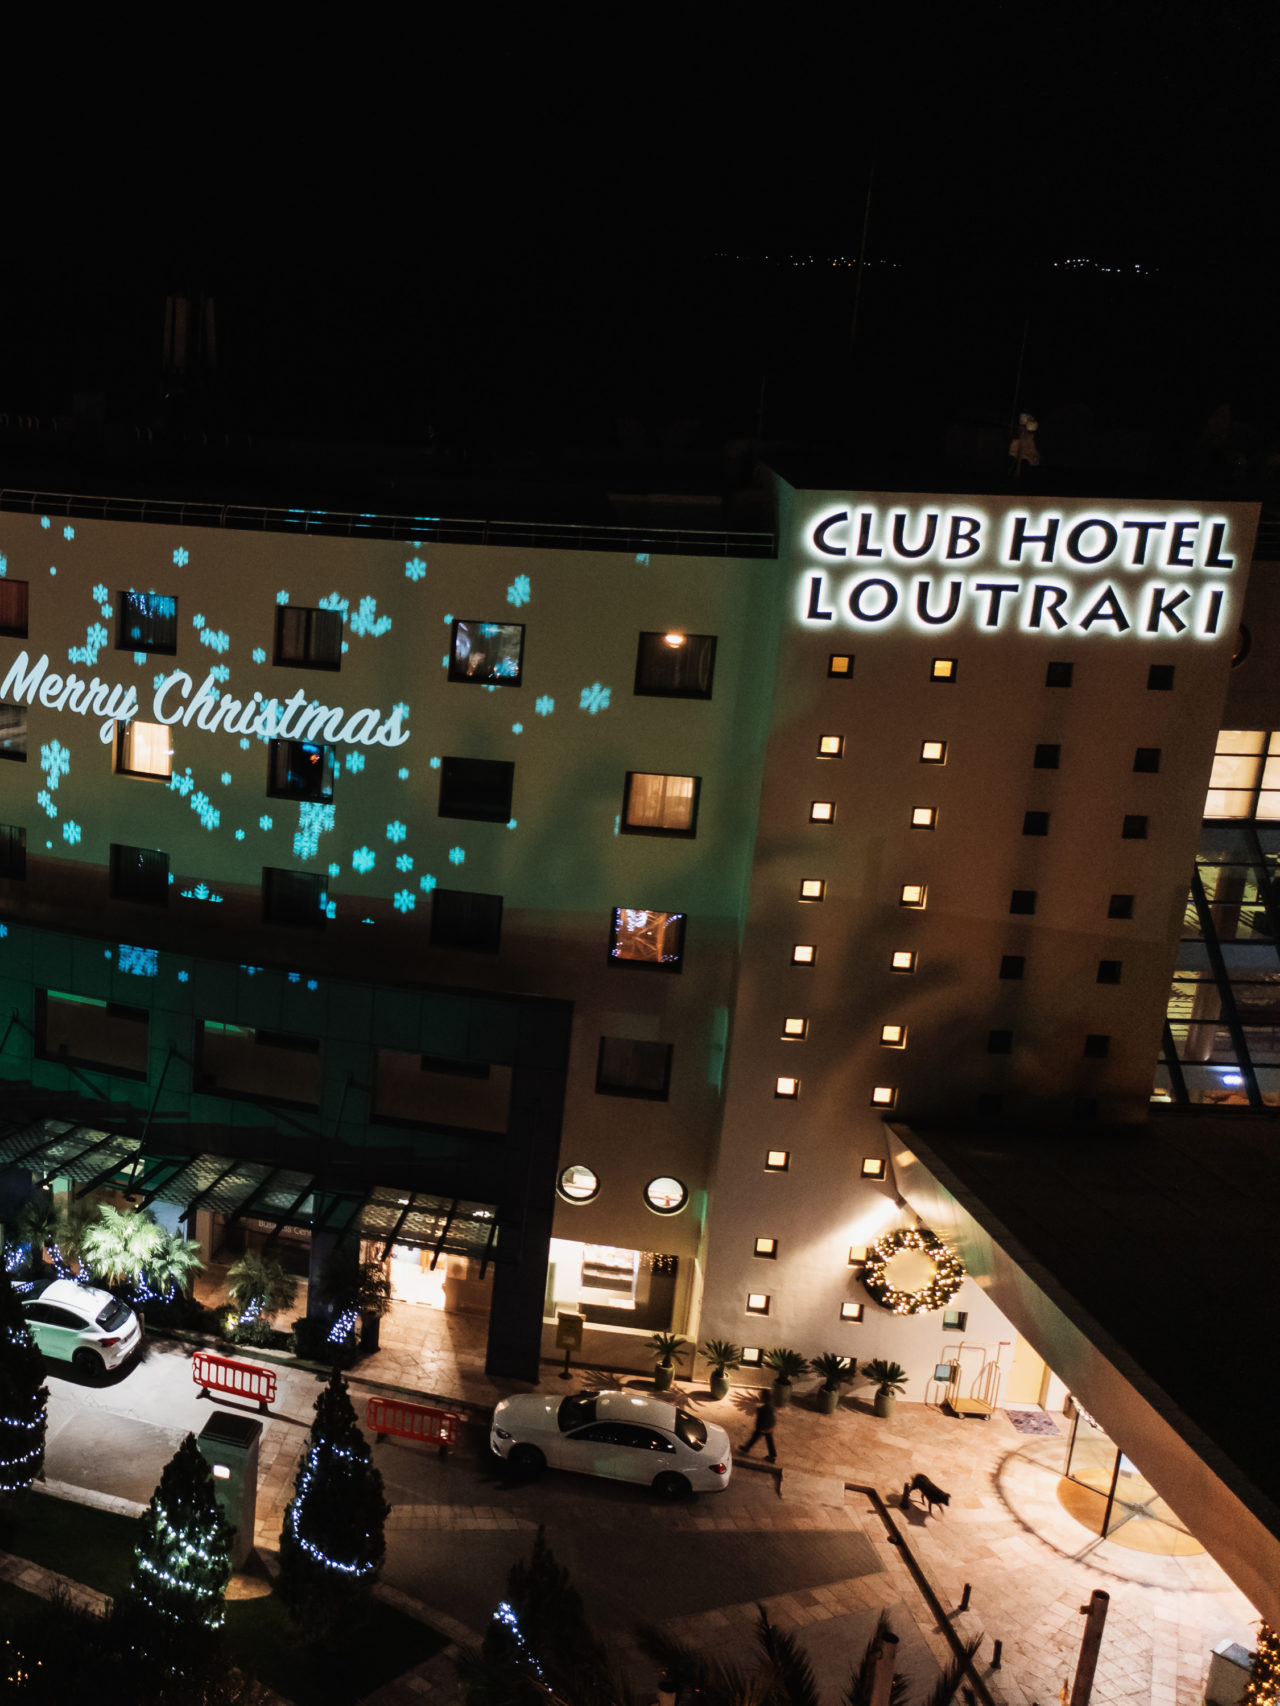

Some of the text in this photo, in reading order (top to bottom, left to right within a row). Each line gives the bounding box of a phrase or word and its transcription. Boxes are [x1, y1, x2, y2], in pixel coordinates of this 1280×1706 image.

[812, 511, 1235, 570] CLUB HOTEL
[806, 576, 1225, 635] LOUTRAKI
[0, 651, 410, 748] Merry Christmas
